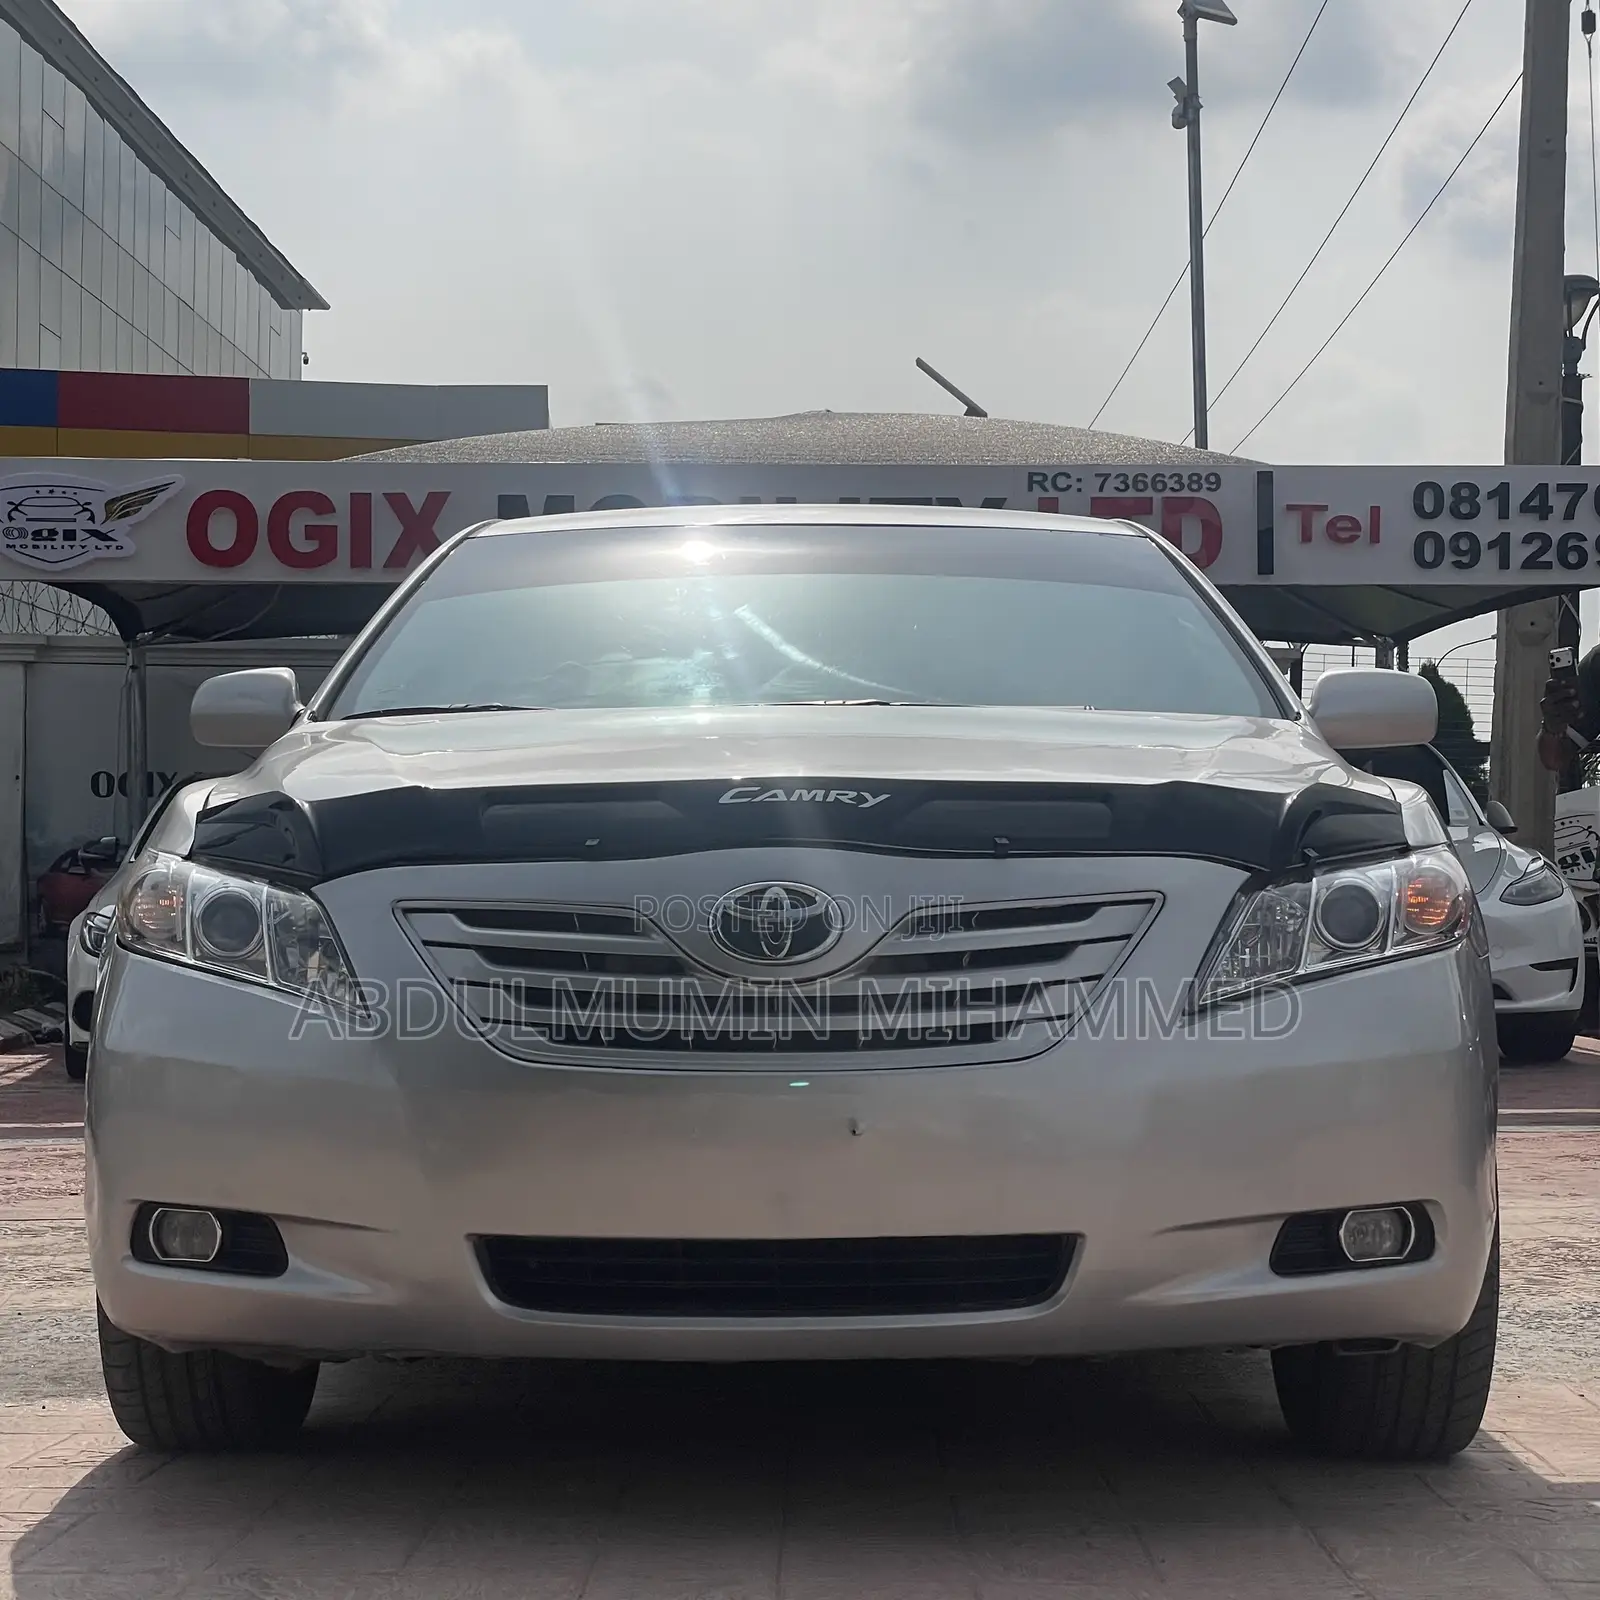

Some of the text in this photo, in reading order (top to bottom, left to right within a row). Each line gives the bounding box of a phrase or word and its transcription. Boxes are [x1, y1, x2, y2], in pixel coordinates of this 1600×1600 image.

[1027, 472, 1222, 493] RC: 7366389
[1412, 481, 1600, 521] 08147
[186, 489, 452, 569] OGIX
[1286, 504, 1381, 545] Tel
[1412, 531, 1600, 570] 09126
[718, 786, 892, 808] CAMRY
